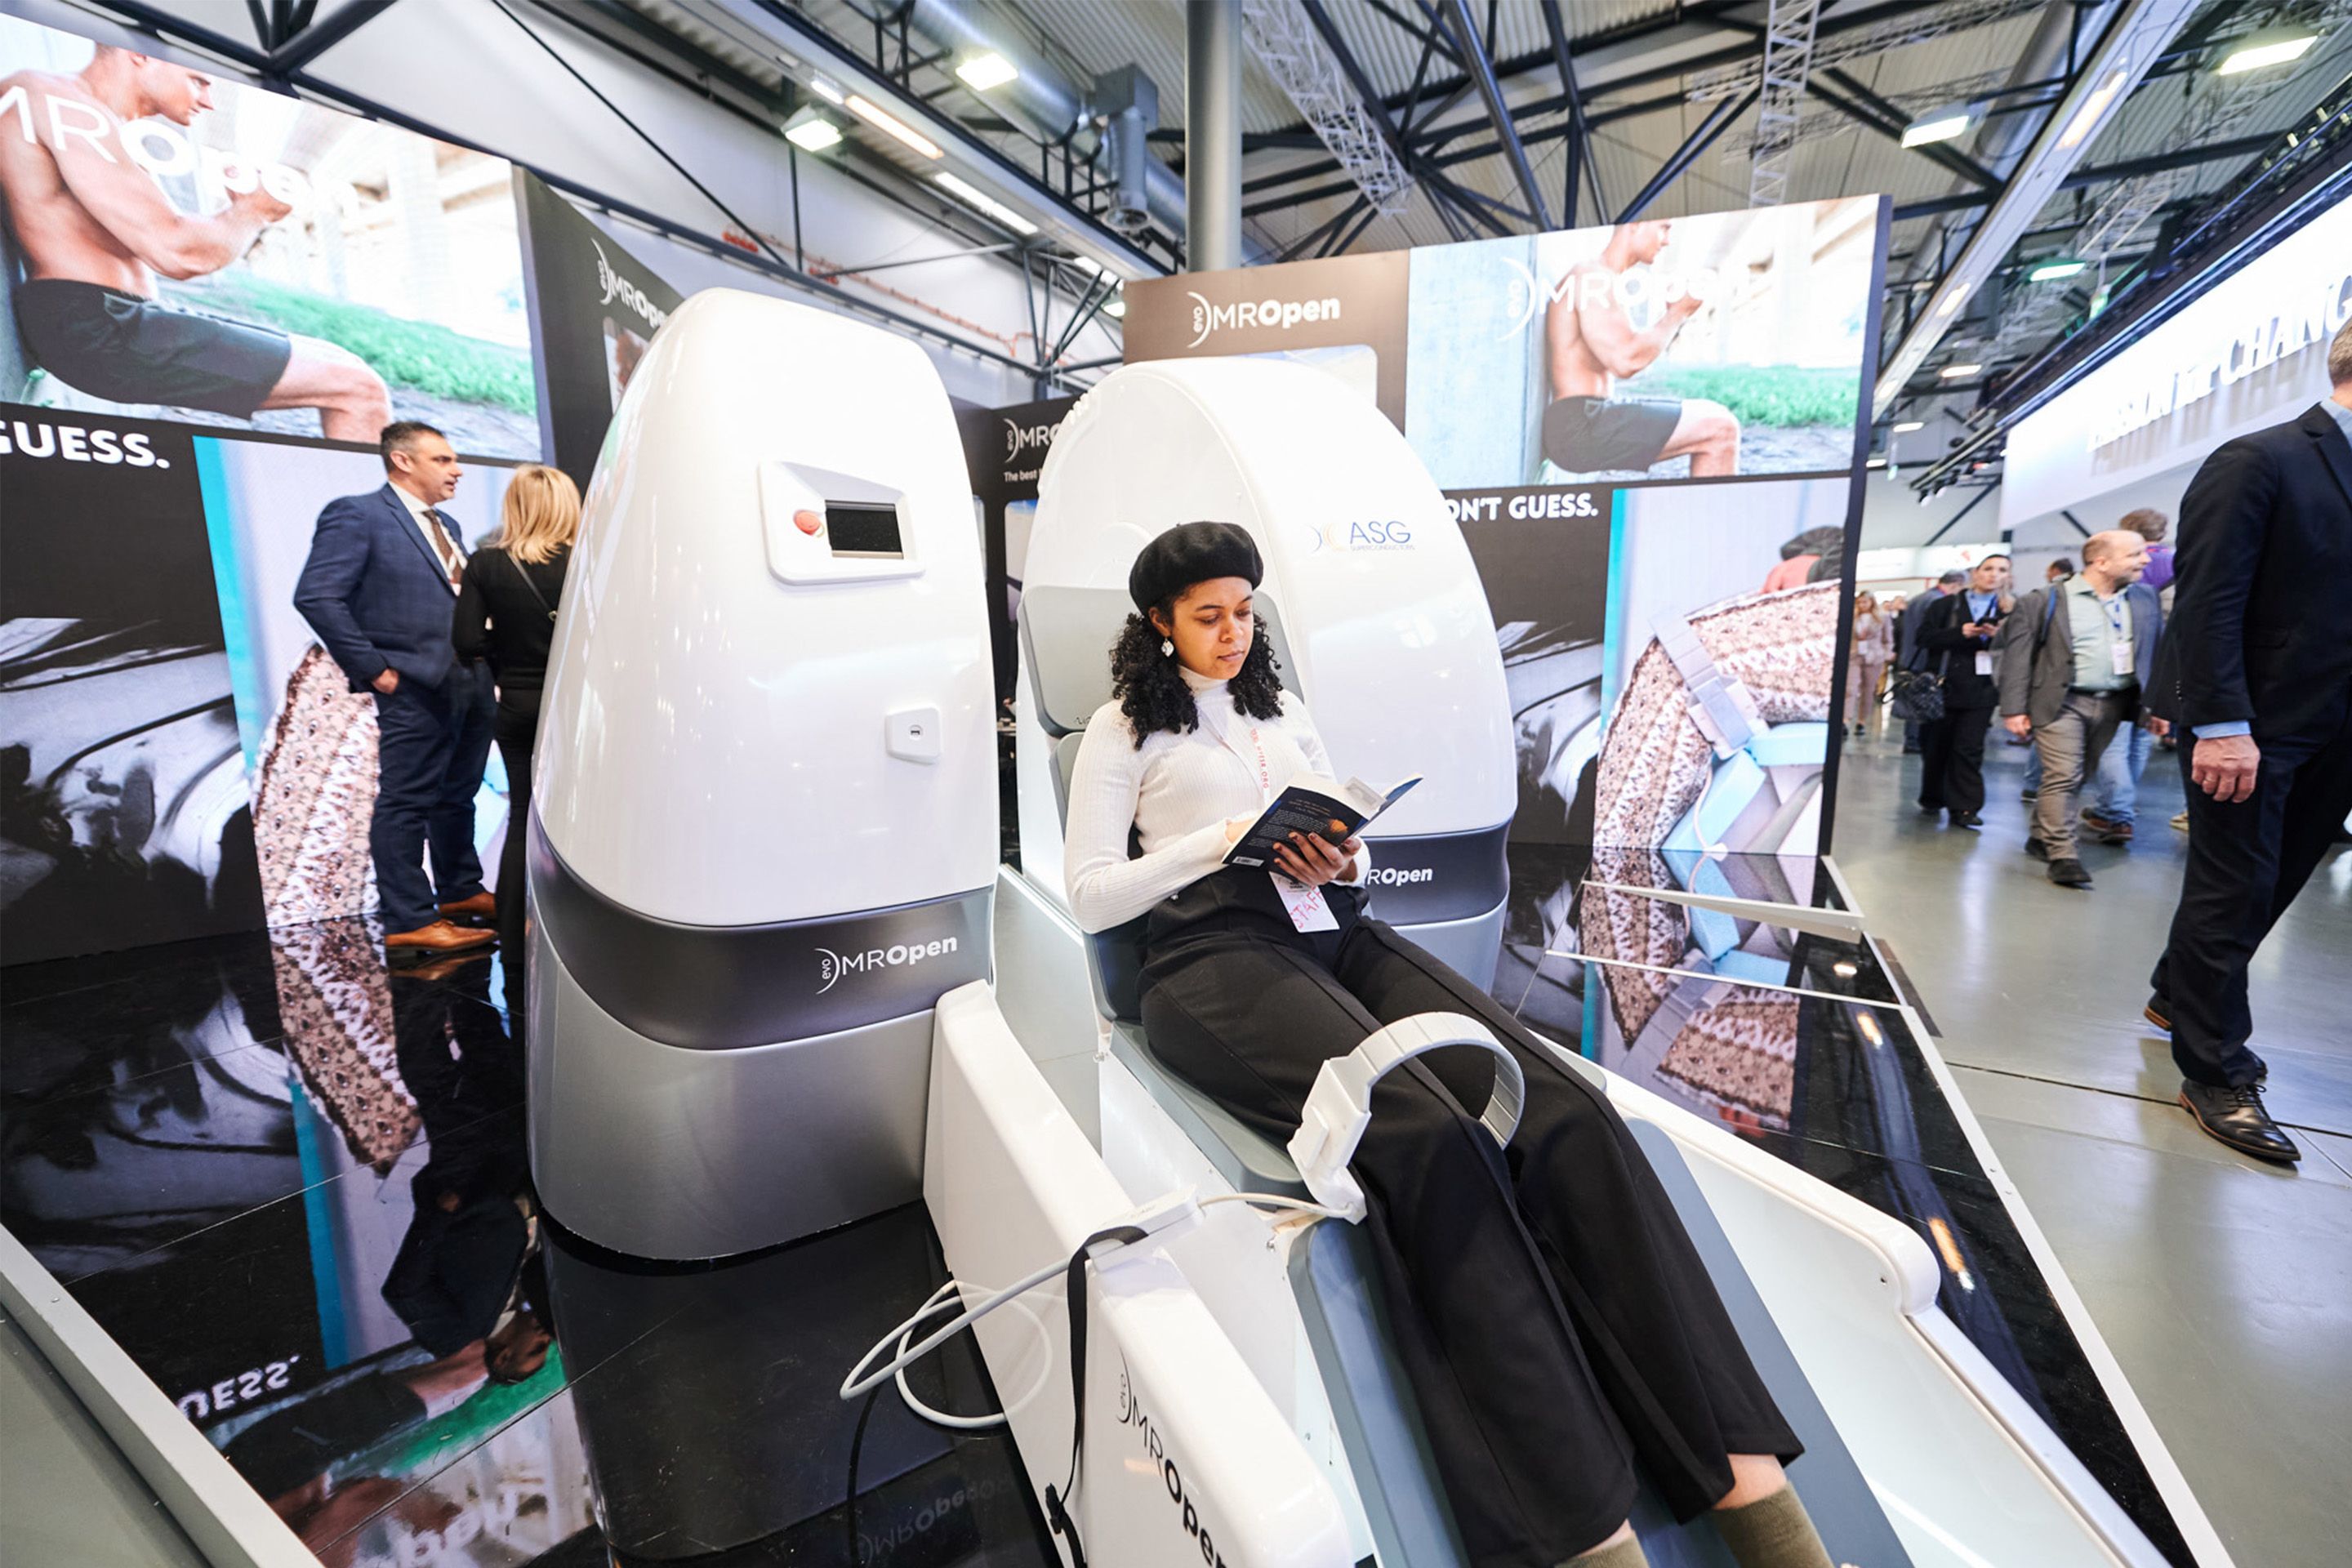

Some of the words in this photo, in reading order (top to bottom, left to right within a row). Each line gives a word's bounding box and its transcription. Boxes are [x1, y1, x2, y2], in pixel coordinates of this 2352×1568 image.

[1212, 297, 1340, 331] MROpen
[1004, 471, 1018, 483] The
[1019, 470, 1037, 481] best
[1508, 492, 1599, 519] GUESS.
[1350, 520, 1411, 545] ASG
[822, 958, 831, 980] evo
[842, 937, 958, 976] MROpen
